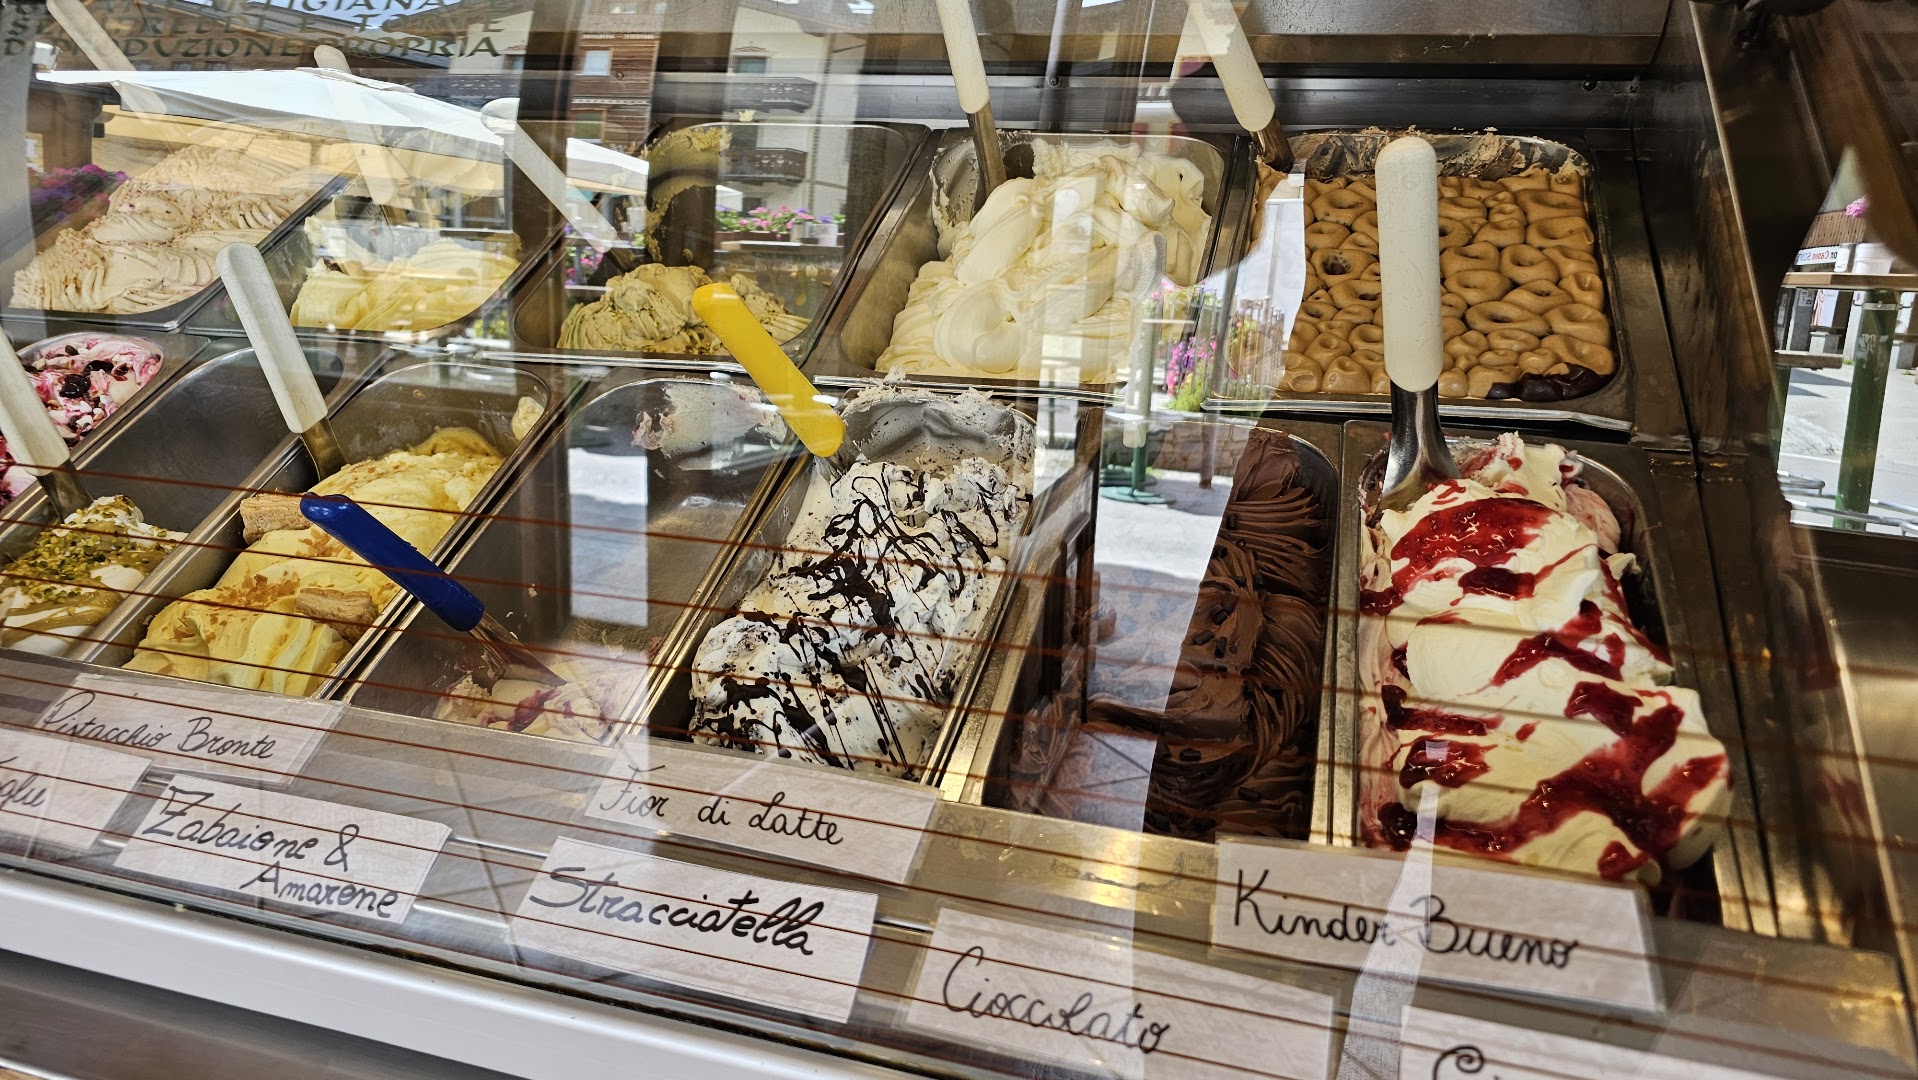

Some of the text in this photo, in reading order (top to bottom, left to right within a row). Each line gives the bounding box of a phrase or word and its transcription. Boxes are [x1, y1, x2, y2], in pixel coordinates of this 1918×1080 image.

[353, 13, 504, 33] TORTE
[43, 691, 276, 759] Pistacchio Bronte
[142, 786, 360, 872] Zabaione &
[600, 764, 844, 845] Fior di Latte
[529, 866, 825, 956] Stracciatella
[1234, 869, 1580, 969] Kinder Bueno
[943, 946, 1171, 1053] Cioccolato
